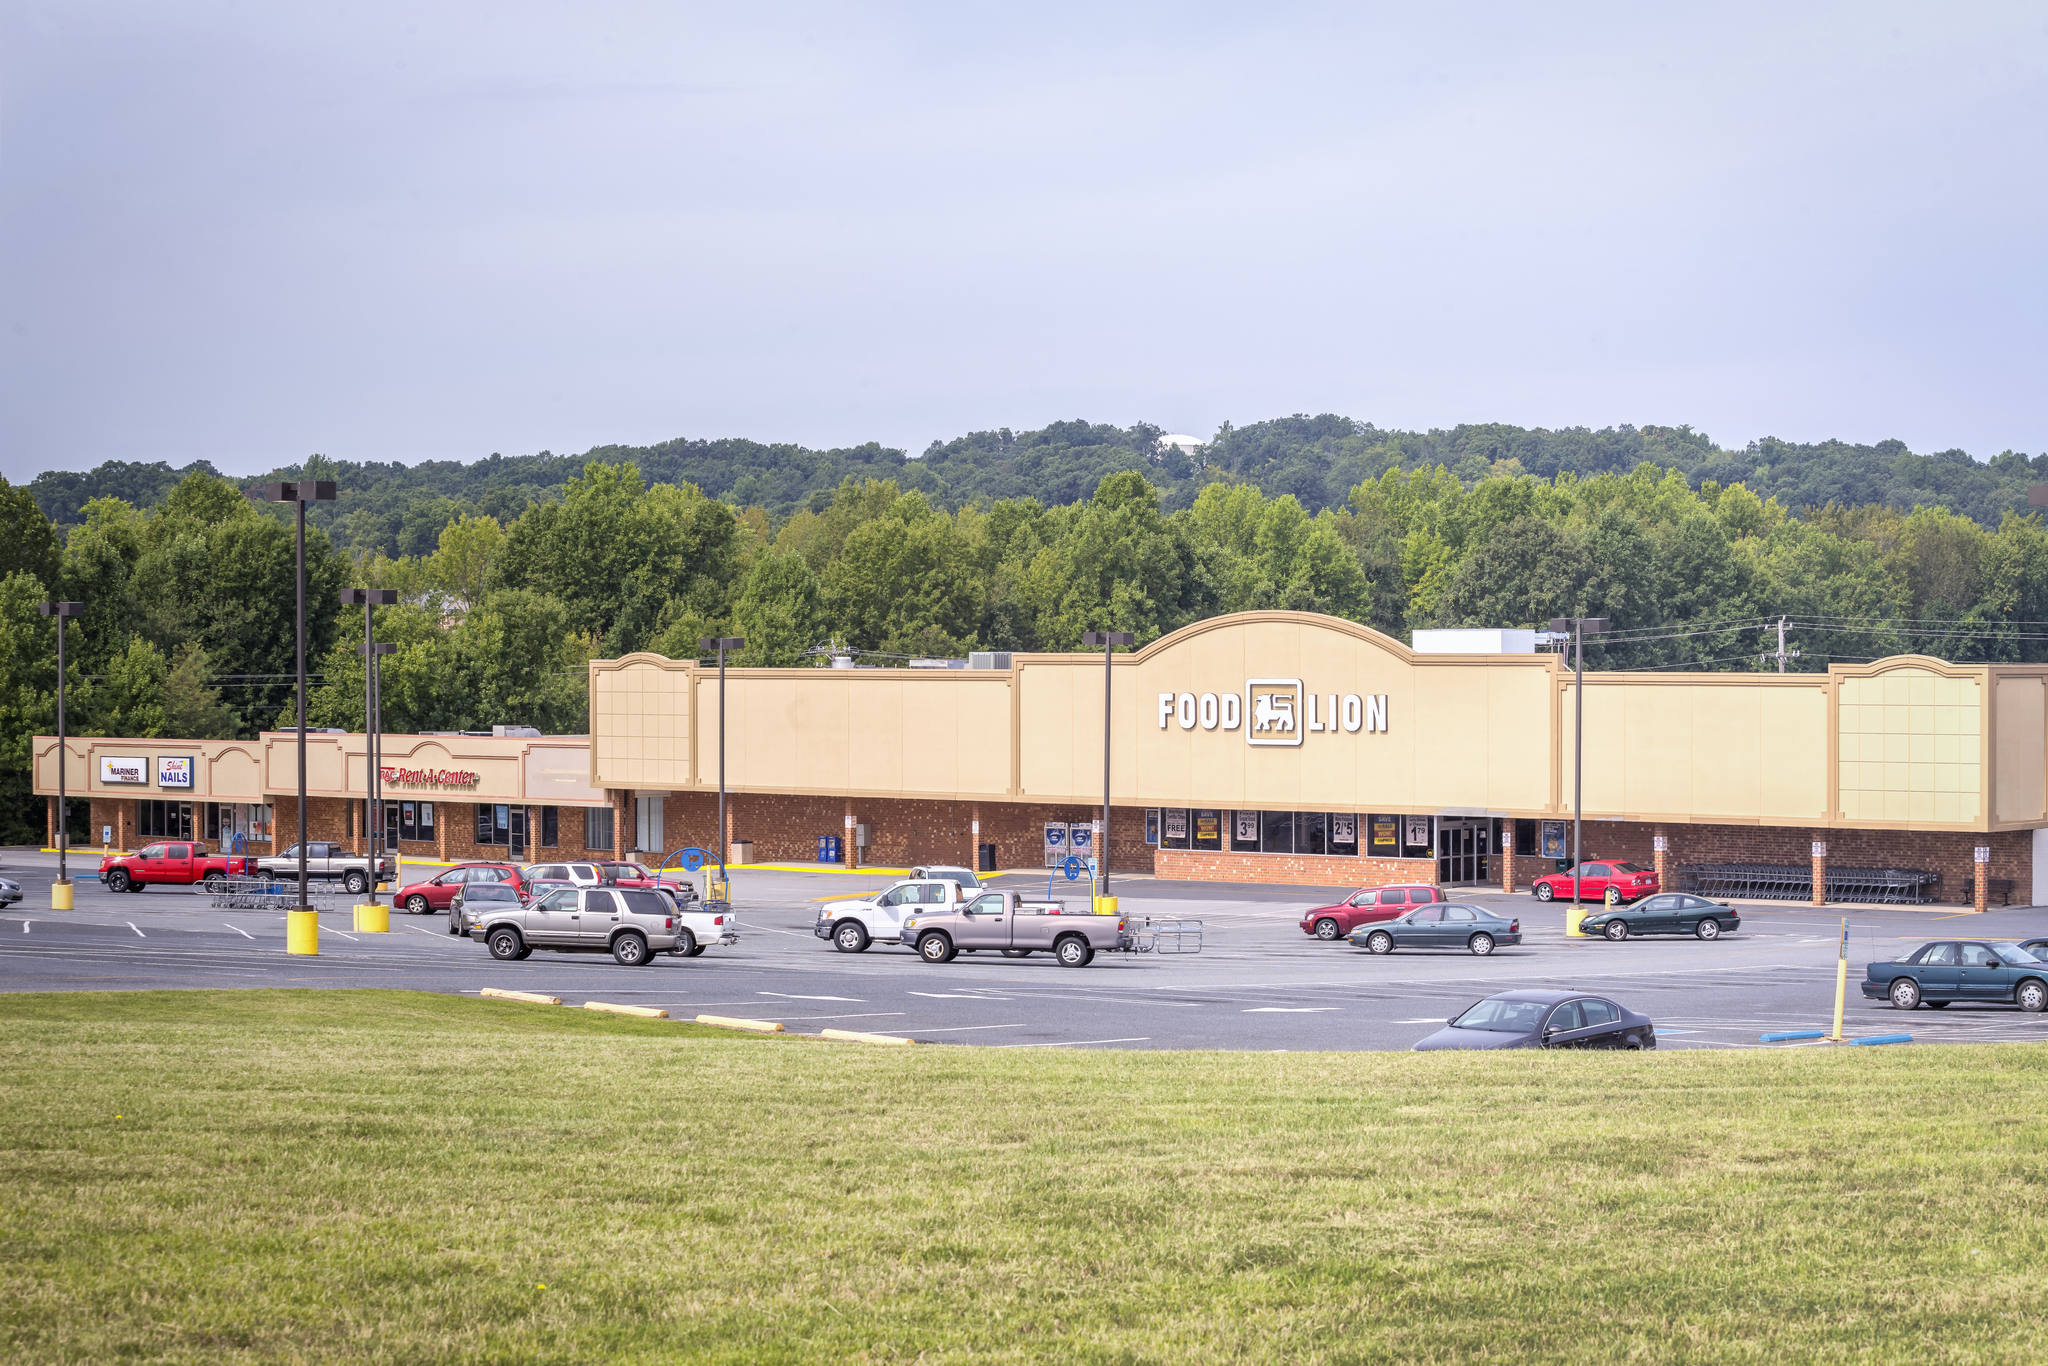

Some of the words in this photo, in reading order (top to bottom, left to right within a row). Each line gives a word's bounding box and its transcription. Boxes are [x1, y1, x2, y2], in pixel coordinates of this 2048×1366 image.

[1158, 692, 1242, 730] FOOD
[1307, 694, 1388, 732] LION
[111, 768, 139, 776] MARINER
[160, 772, 188, 783] NAILS
[1167, 824, 1185, 832] FREE
